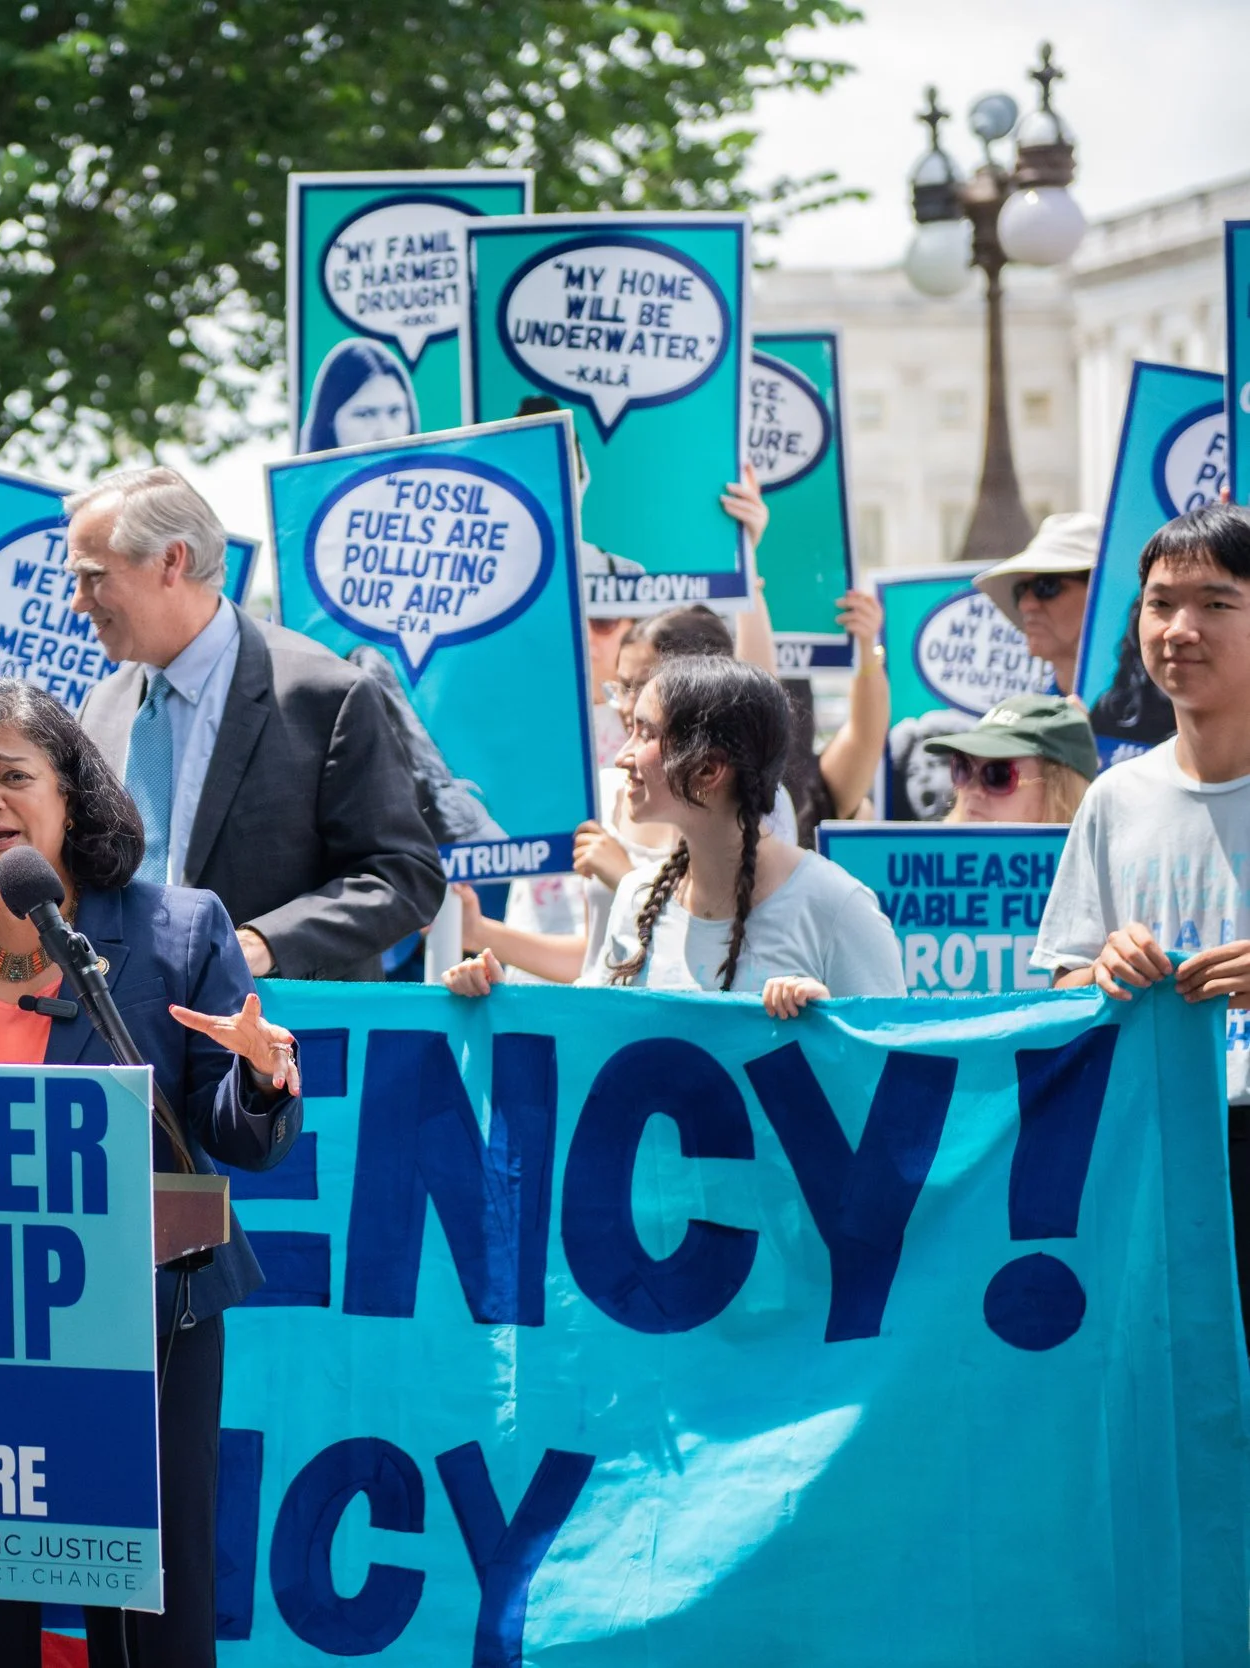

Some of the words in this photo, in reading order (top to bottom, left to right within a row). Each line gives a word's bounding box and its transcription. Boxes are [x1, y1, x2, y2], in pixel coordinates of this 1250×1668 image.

[619, 268, 695, 301] HOME
[566, 294, 626, 324] WILL
[638, 302, 674, 329] BE
[386, 474, 490, 516] "FOSSIL
[346, 509, 436, 545] FUELS
[445, 519, 509, 552] ARE
[342, 544, 498, 585] POLLUTING
[340, 577, 393, 609] OUR
[20, 597, 97, 644] CLIM
[887, 852, 1055, 888] UNLEASH
[30, 1536, 144, 1564] JUSTICE
[31, 1567, 143, 1591] CHANGE.
